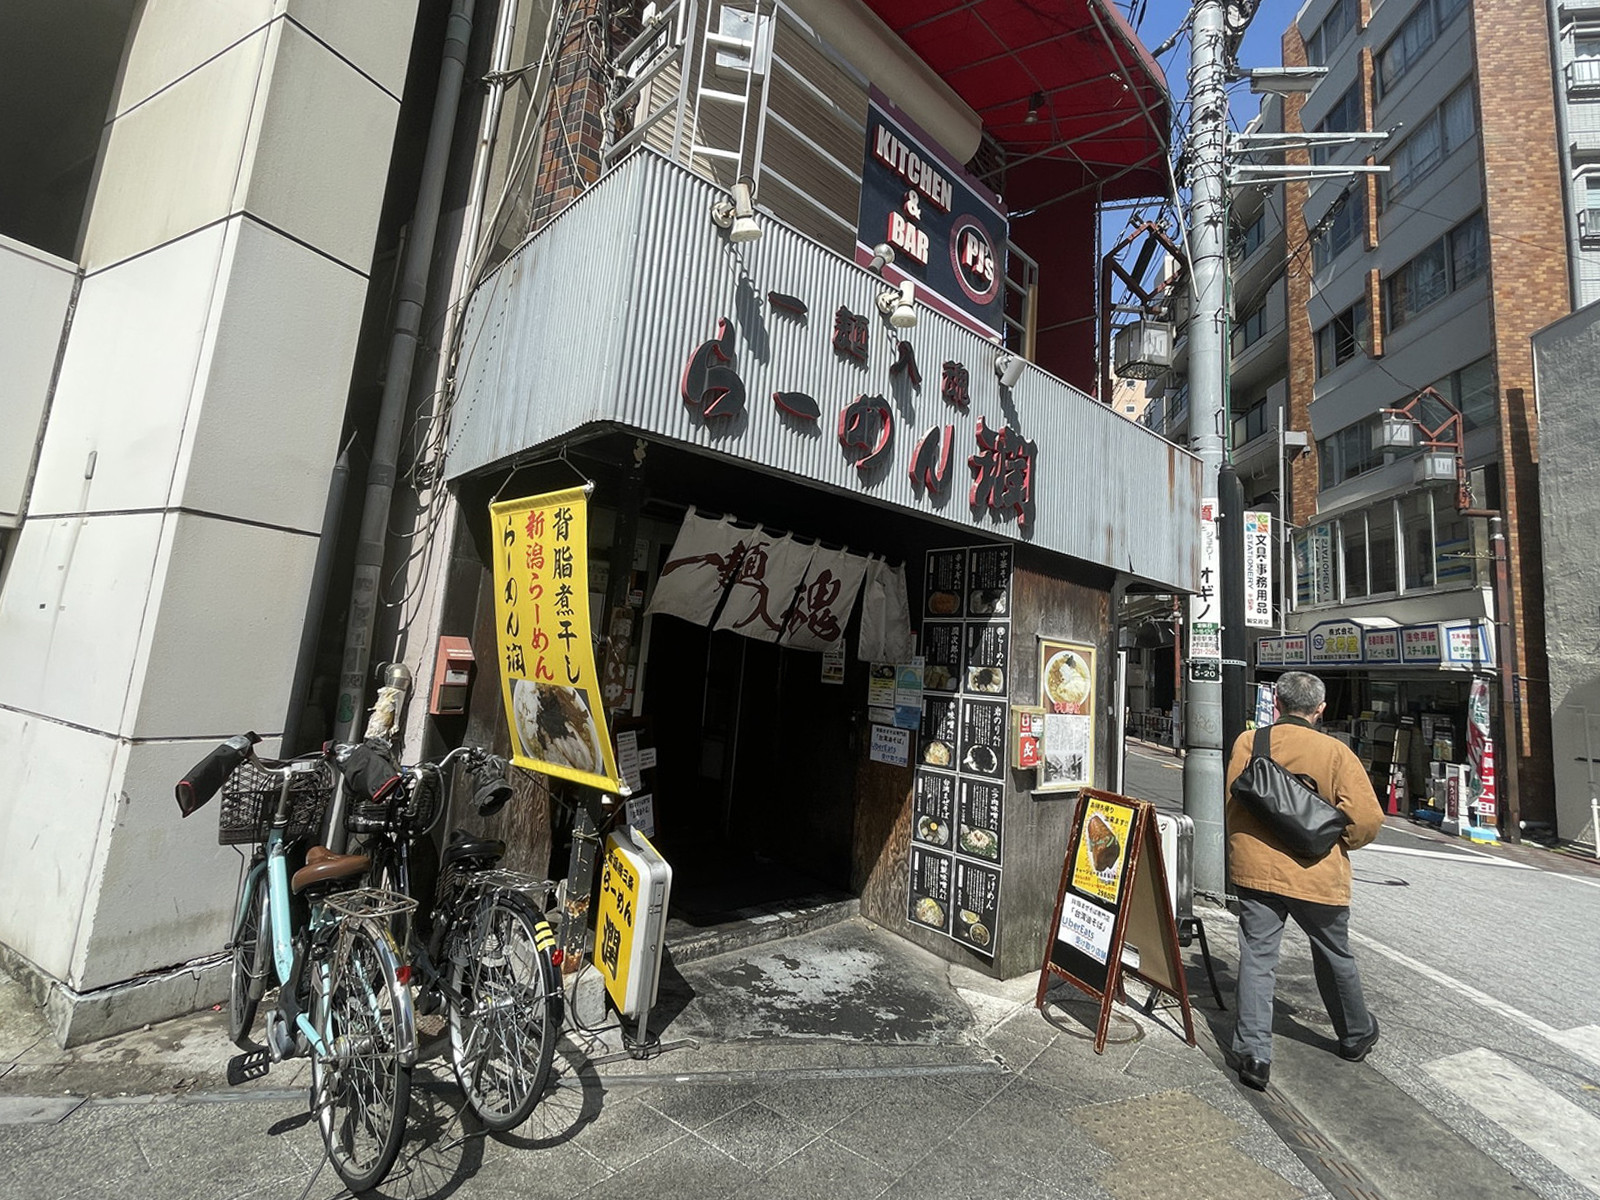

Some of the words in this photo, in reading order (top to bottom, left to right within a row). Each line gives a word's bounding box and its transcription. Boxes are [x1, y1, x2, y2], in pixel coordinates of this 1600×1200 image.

[875, 124, 953, 212] KITCHEN
[904, 188, 921, 220] &
[889, 211, 929, 266] BAR
[1246, 533, 1254, 590] STATIONERY
[1256, 534, 1268, 615] 文具・事務用品
[503, 515, 527, 679] らーめん潤
[525, 510, 554, 681] 新潟らーめん
[552, 507, 581, 684] 背脂煮干し
[1197, 566, 1214, 620] オギノ
[603, 871, 632, 928] らーめん
[986, 873, 997, 911] つけめん
[1062, 916, 1095, 939] UberEats
[1075, 936, 1106, 960] 受け取り店舗
